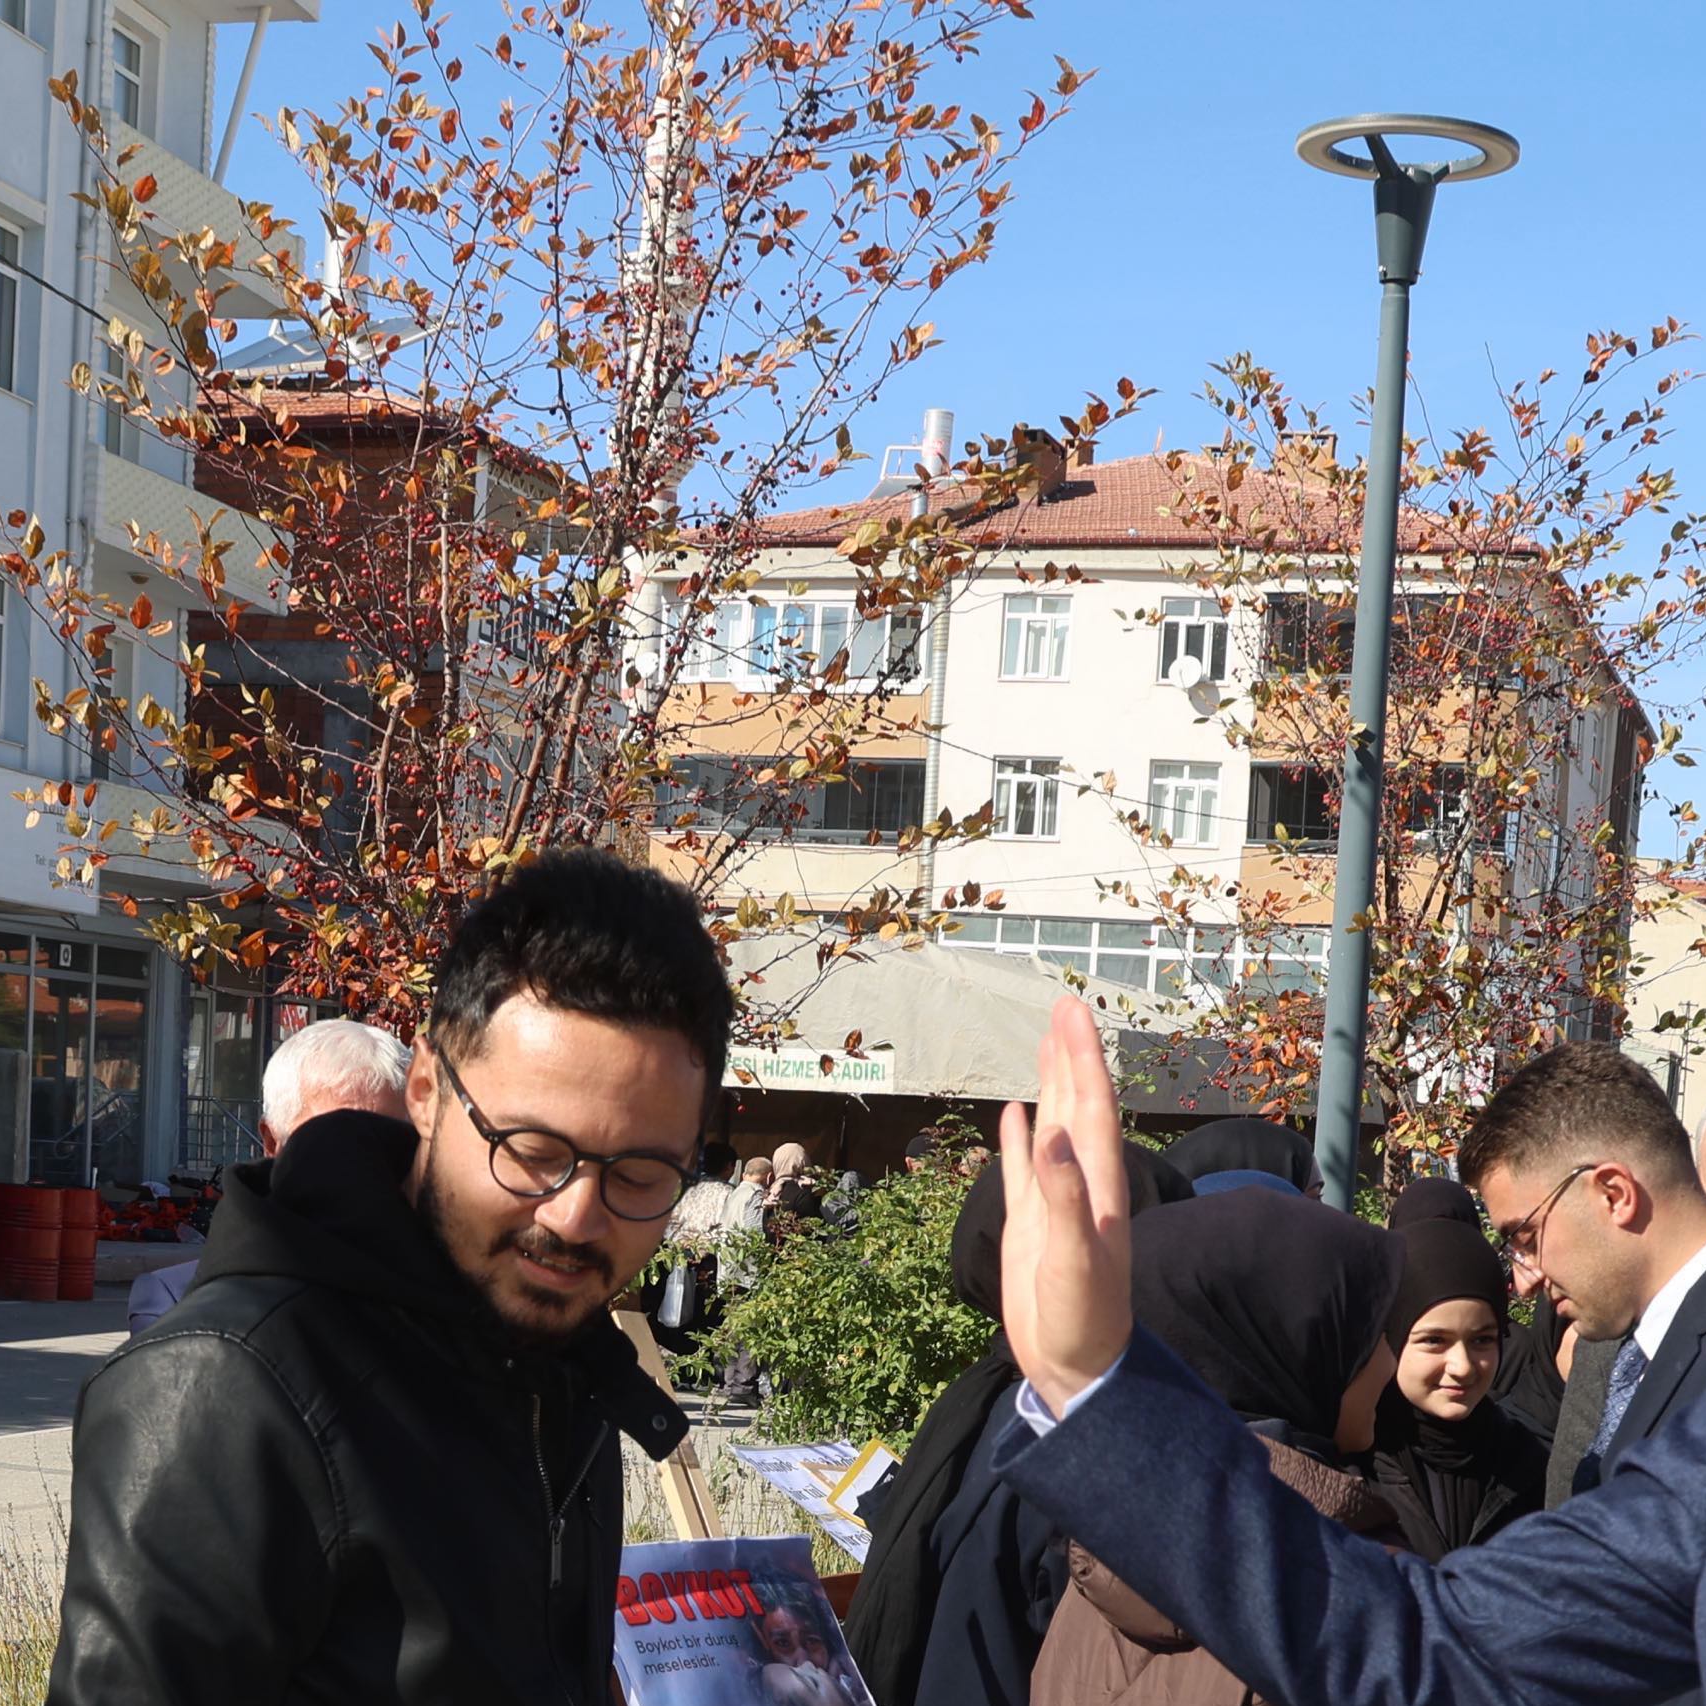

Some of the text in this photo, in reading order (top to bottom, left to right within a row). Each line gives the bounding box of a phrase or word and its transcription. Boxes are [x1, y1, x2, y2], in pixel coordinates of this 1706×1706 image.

[831, 1060, 886, 1085] ÇADIRI
[615, 1568, 766, 1627] BOYKOT
[634, 1632, 741, 1655] Boykot bir duruş
[643, 1654, 720, 1675] meselesidir.
